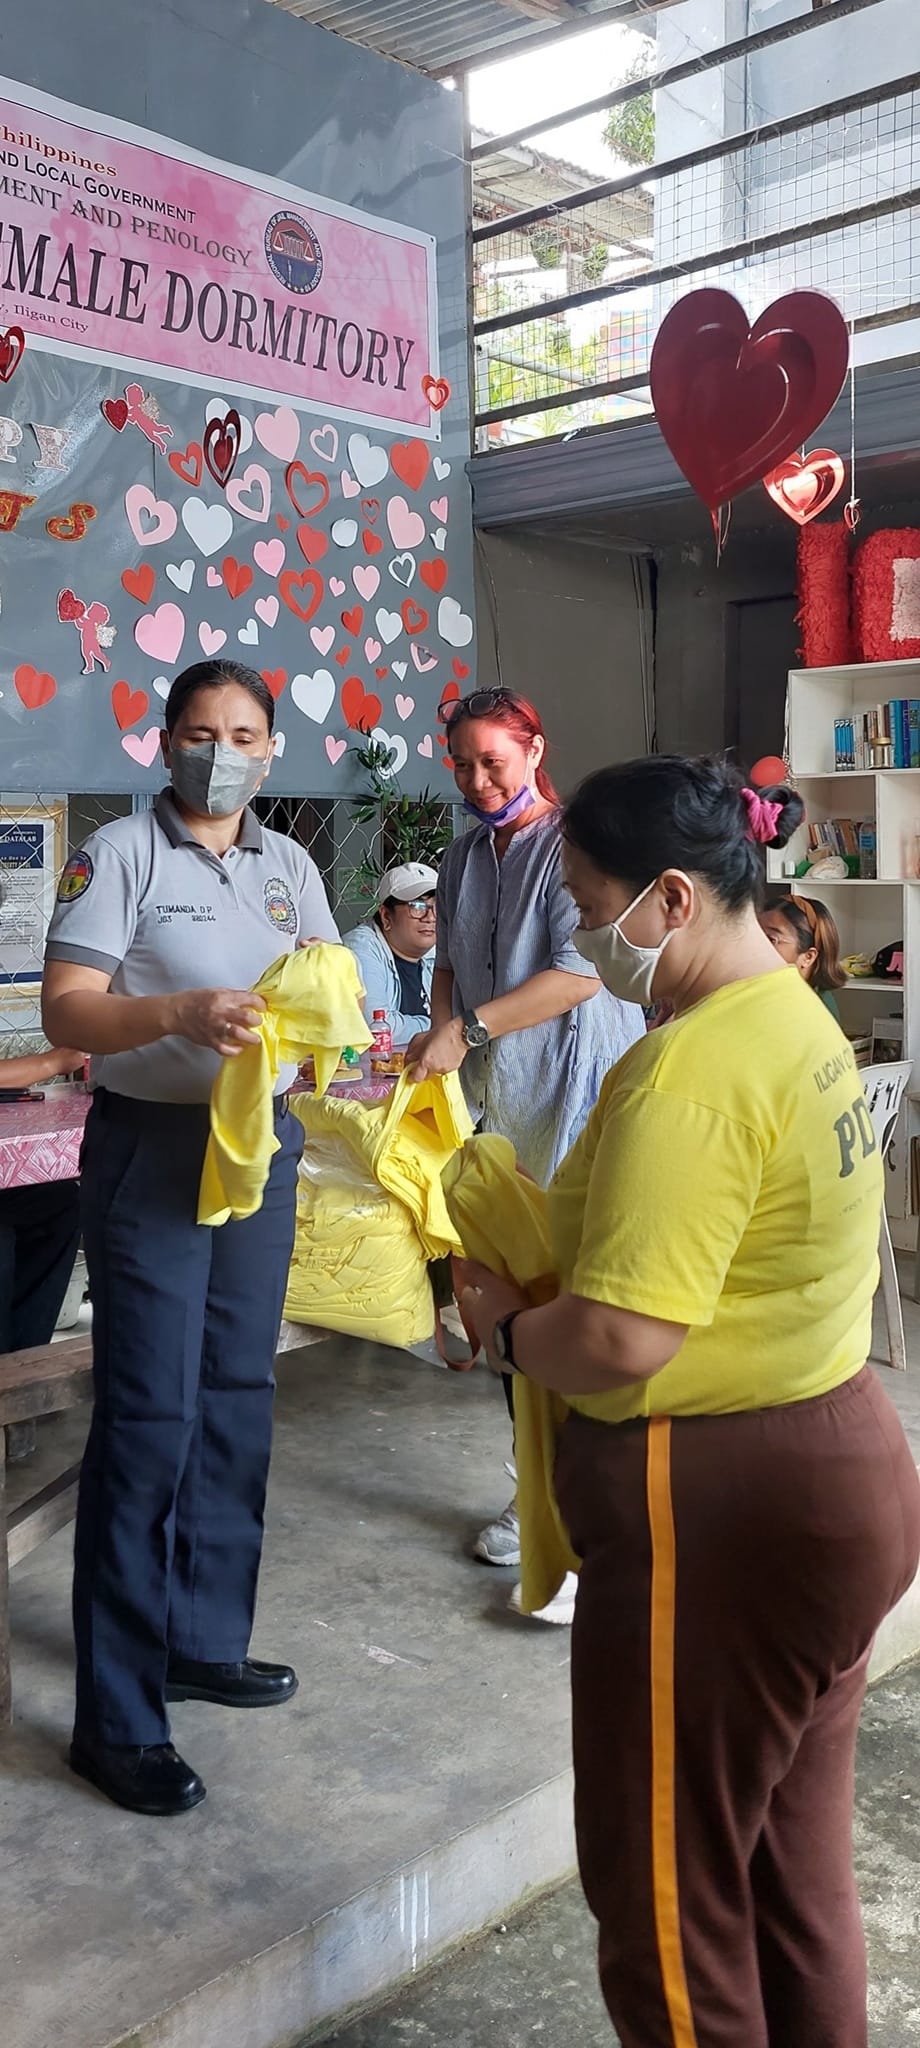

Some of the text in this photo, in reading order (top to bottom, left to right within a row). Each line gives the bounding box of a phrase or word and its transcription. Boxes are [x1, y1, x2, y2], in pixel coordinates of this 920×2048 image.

[0, 125, 117, 177] hilippines
[24, 154, 80, 189] LOCAL
[84, 176, 197, 224] GOVERNMENT
[70, 199, 122, 229] AND
[131, 215, 253, 268] PENOLOGY
[0, 221, 415, 391] MALE DORMITORY
[14, 304, 56, 324] Iligan
[60, 317, 89, 333] City
[813, 1053, 847, 1094] ILIGAN
